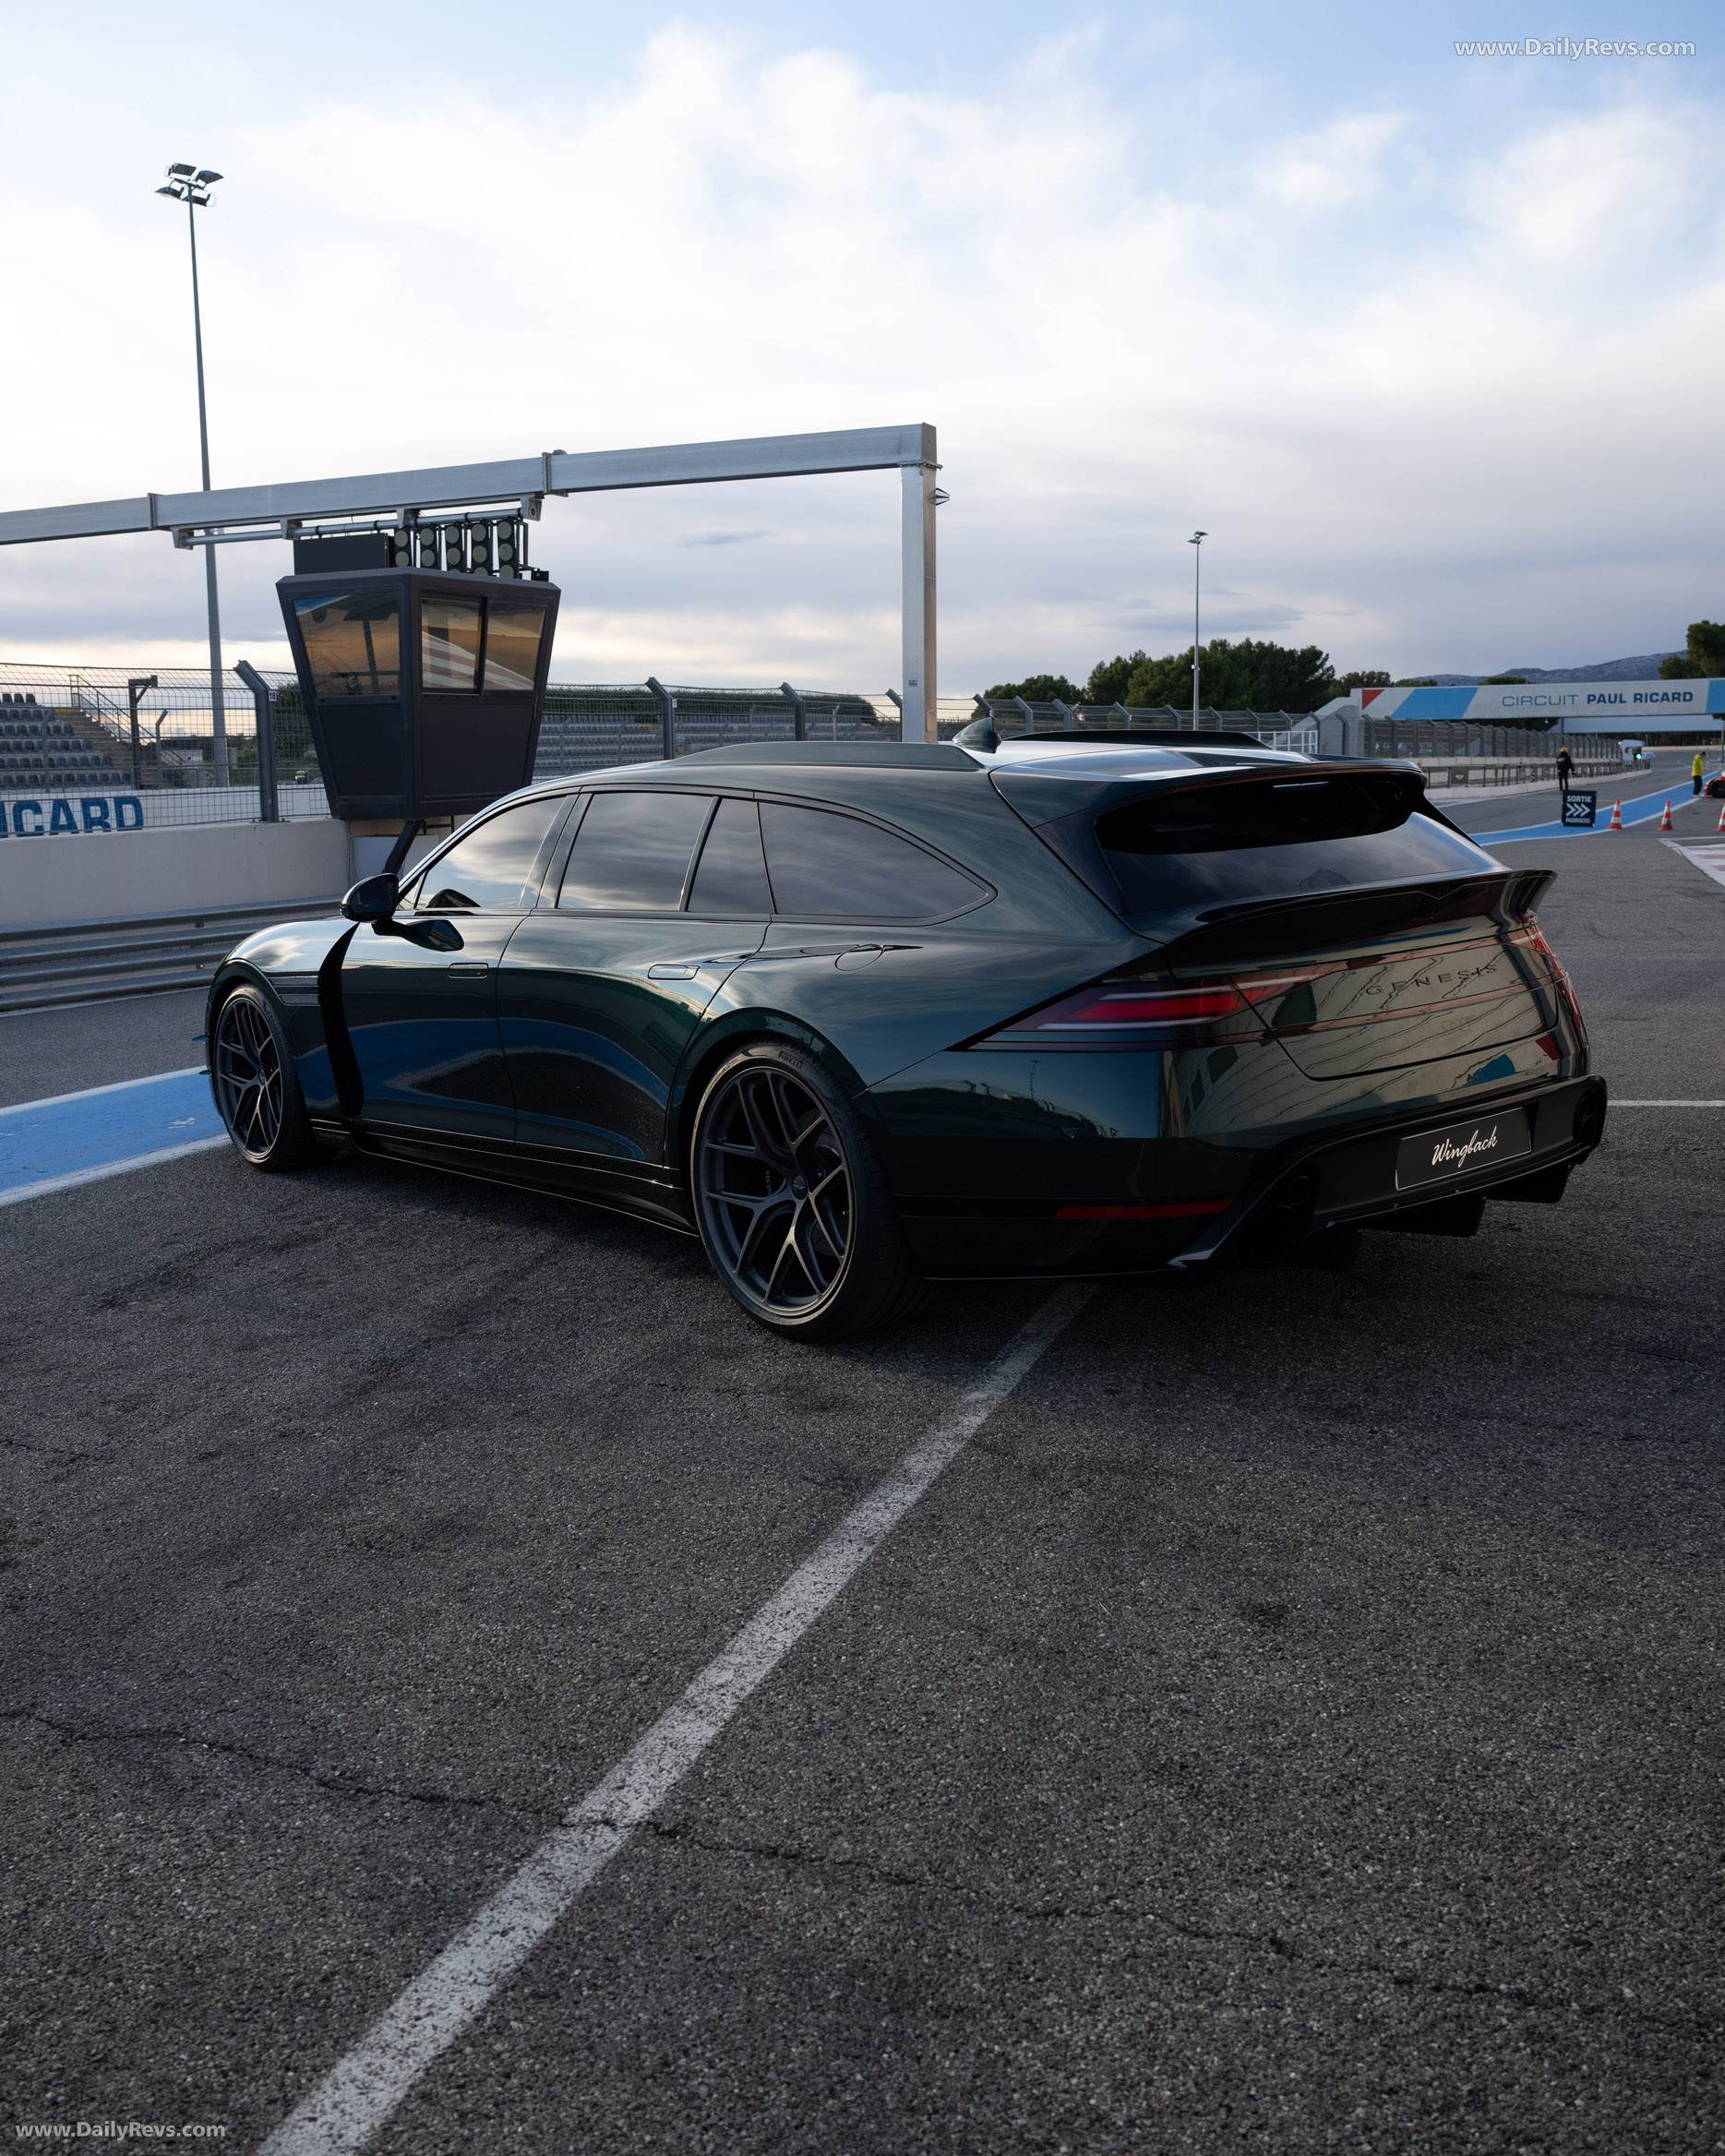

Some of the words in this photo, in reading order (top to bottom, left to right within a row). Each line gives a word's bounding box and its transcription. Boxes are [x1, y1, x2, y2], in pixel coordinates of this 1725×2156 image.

[269, 691, 276, 701] 18
[1502, 694, 1579, 707] CIRCUIT
[1587, 692, 1627, 705] PAUL
[1633, 691, 1694, 704] RICARD
[1566, 795, 1592, 803] SORTIE
[1366, 964, 1498, 996] GENESIS
[778, 1050, 803, 1070] PIRELLI
[1432, 1125, 1498, 1168] Wingback
